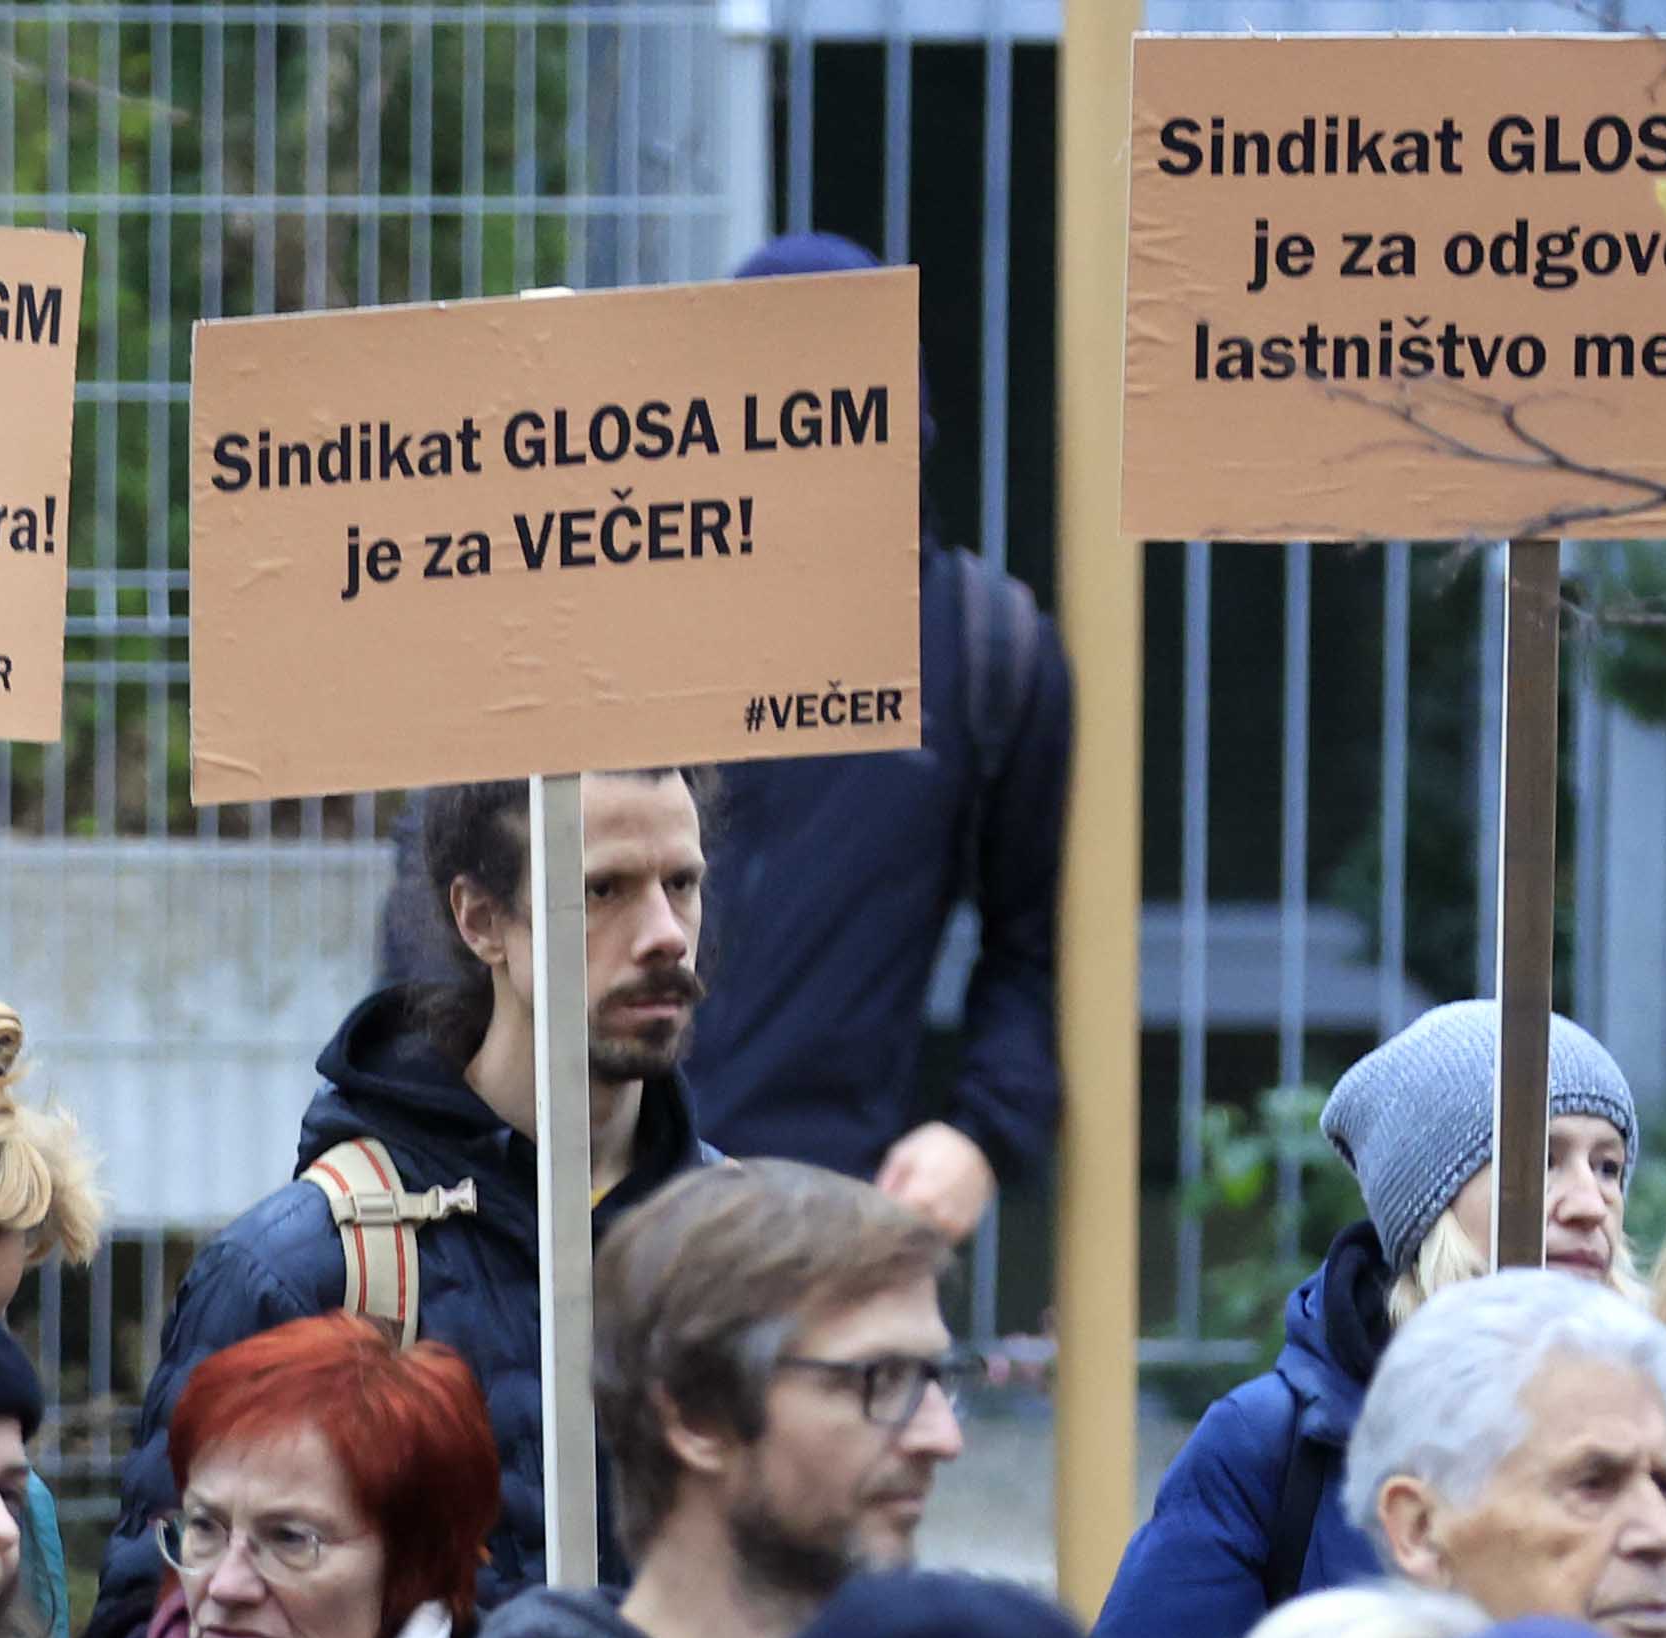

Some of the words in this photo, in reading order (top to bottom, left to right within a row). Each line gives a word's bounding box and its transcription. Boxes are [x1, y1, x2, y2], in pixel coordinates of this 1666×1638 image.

[1157, 115, 1463, 177] Sindikat
[1246, 218, 1316, 293] je
[1339, 233, 1416, 277] za
[1194, 315, 1547, 381] lastništvo
[211, 416, 482, 493] Sindikat
[503, 397, 720, 470] GLOSA
[744, 386, 889, 452] LGM
[340, 525, 402, 602] je
[423, 528, 491, 579] za
[513, 487, 754, 571] VEČER!
[745, 681, 903, 732] #VEČER
